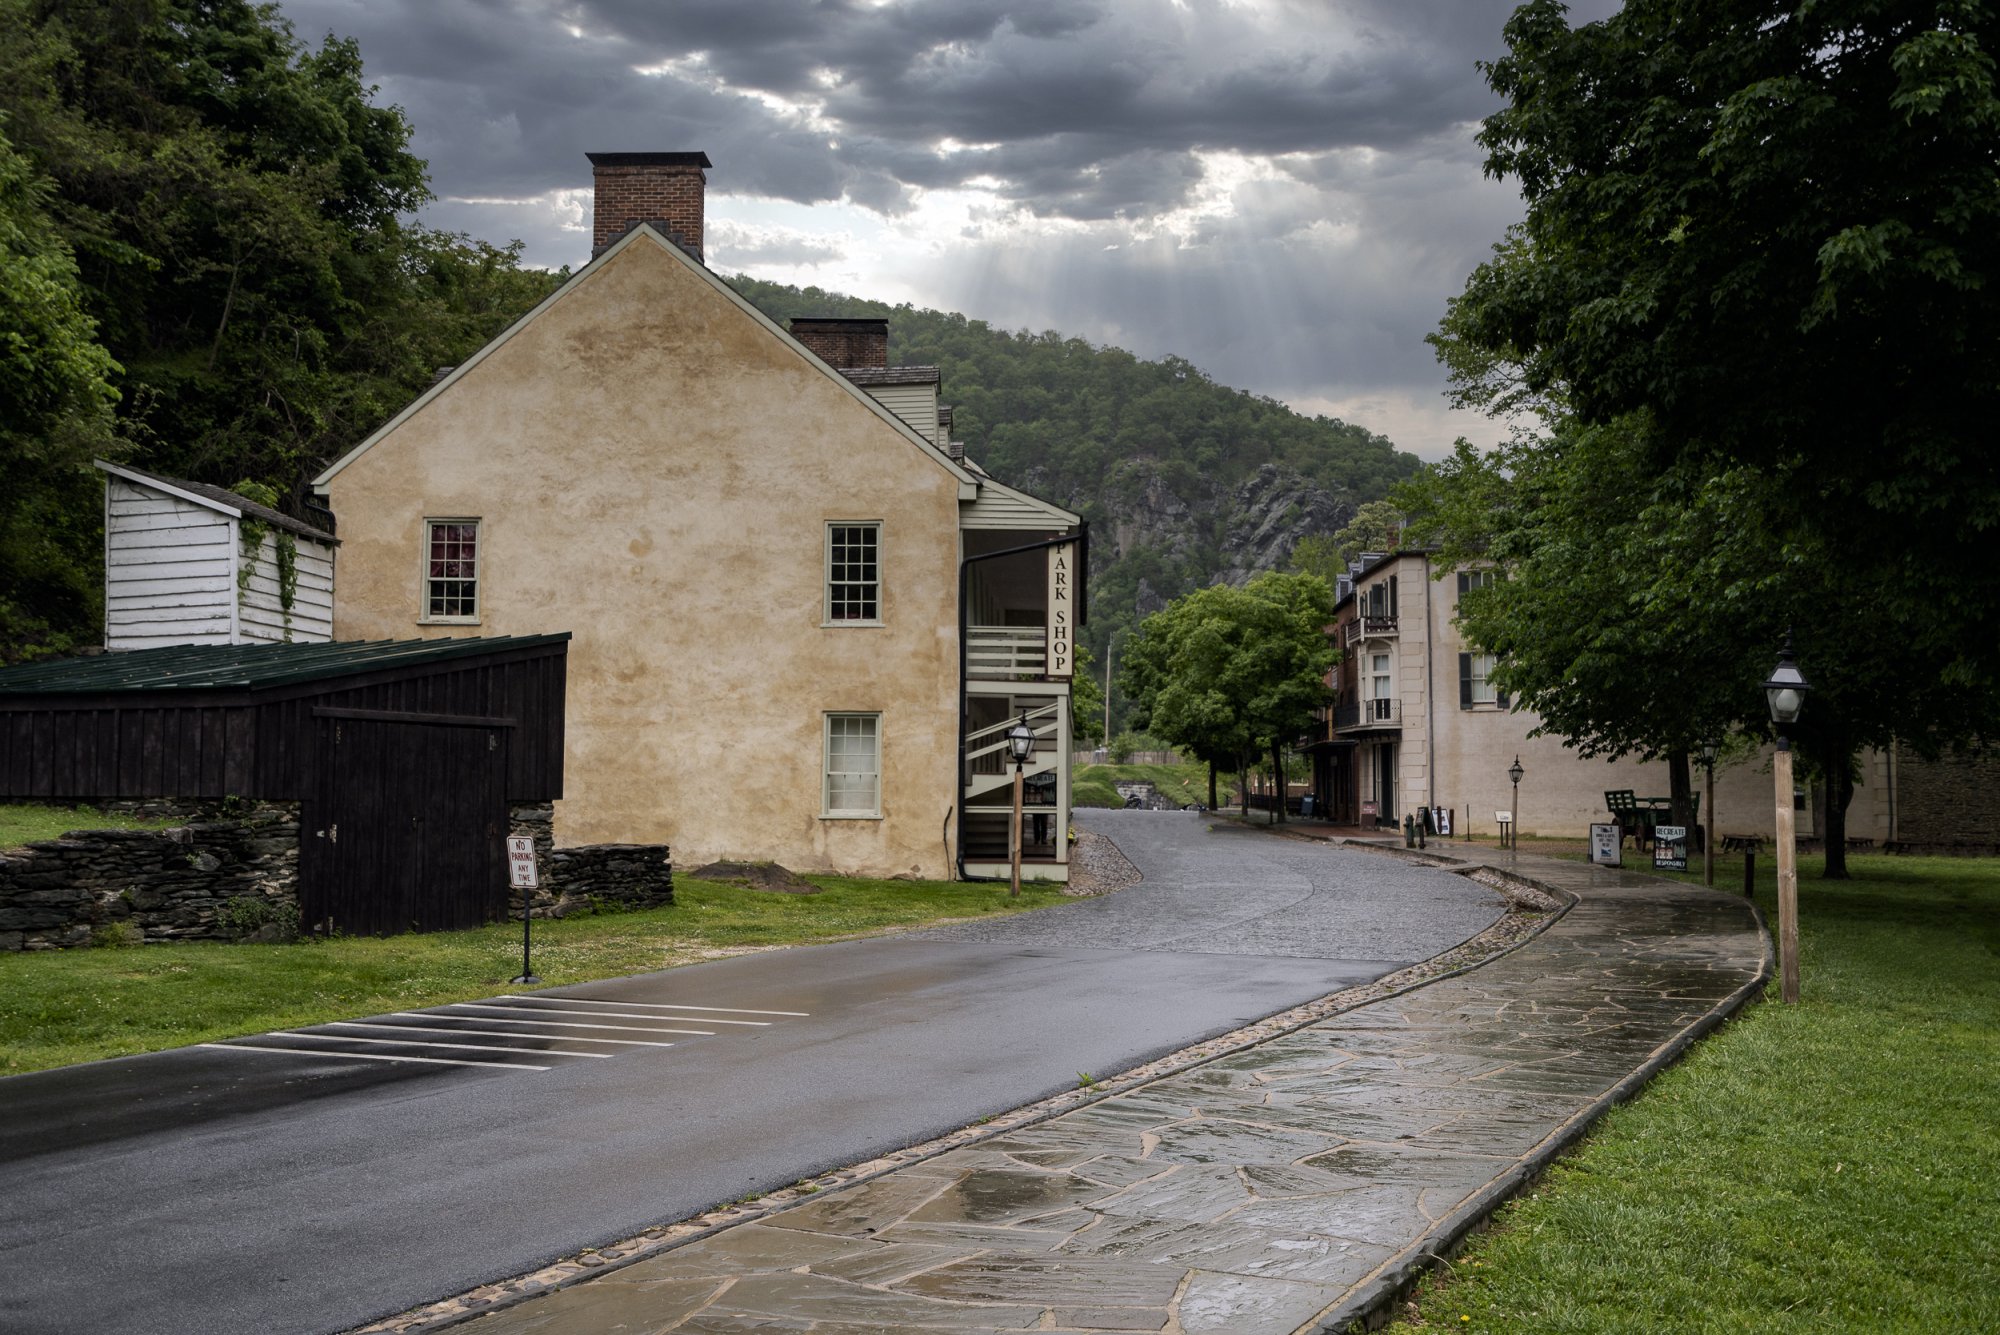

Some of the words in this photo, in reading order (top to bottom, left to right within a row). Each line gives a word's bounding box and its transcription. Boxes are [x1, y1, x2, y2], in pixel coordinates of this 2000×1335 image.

[1055, 543, 1067, 600] PARK
[1054, 611, 1067, 670] SHOP
[1656, 827, 1685, 836] RECREATE
[515, 840, 526, 850] NO
[511, 852, 532, 862] PARKING
[518, 864, 529, 872] ANY
[518, 874, 531, 882] TIME
